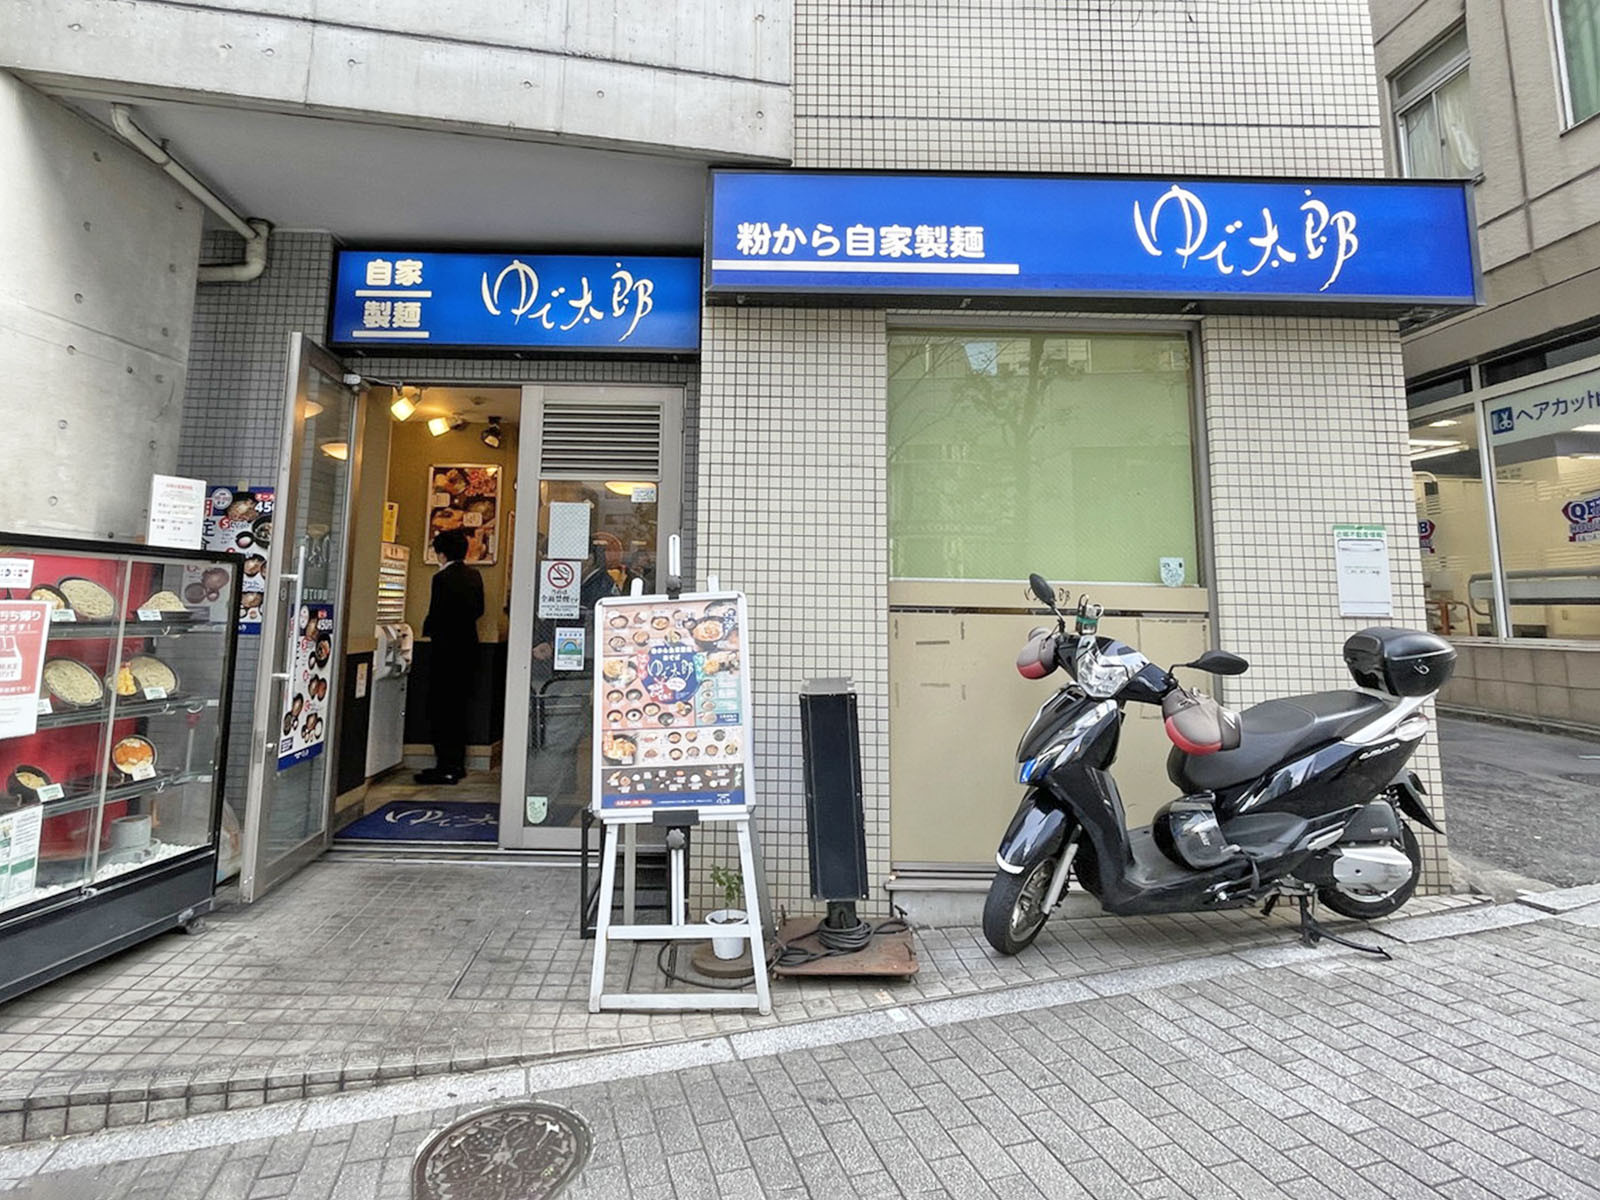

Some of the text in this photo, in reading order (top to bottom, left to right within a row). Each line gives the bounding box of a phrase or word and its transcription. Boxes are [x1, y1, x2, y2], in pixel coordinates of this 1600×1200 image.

[736, 221, 986, 259] 粉から自家製麺
[1133, 183, 1359, 292] ゆで太郎
[365, 258, 424, 287] 自家
[362, 300, 422, 329] 製麺
[481, 259, 655, 342] ゆで太郎
[1516, 389, 1600, 421] ヘアカット
[254, 501, 273, 513] 45
[385, 808, 498, 828] ゆで太
